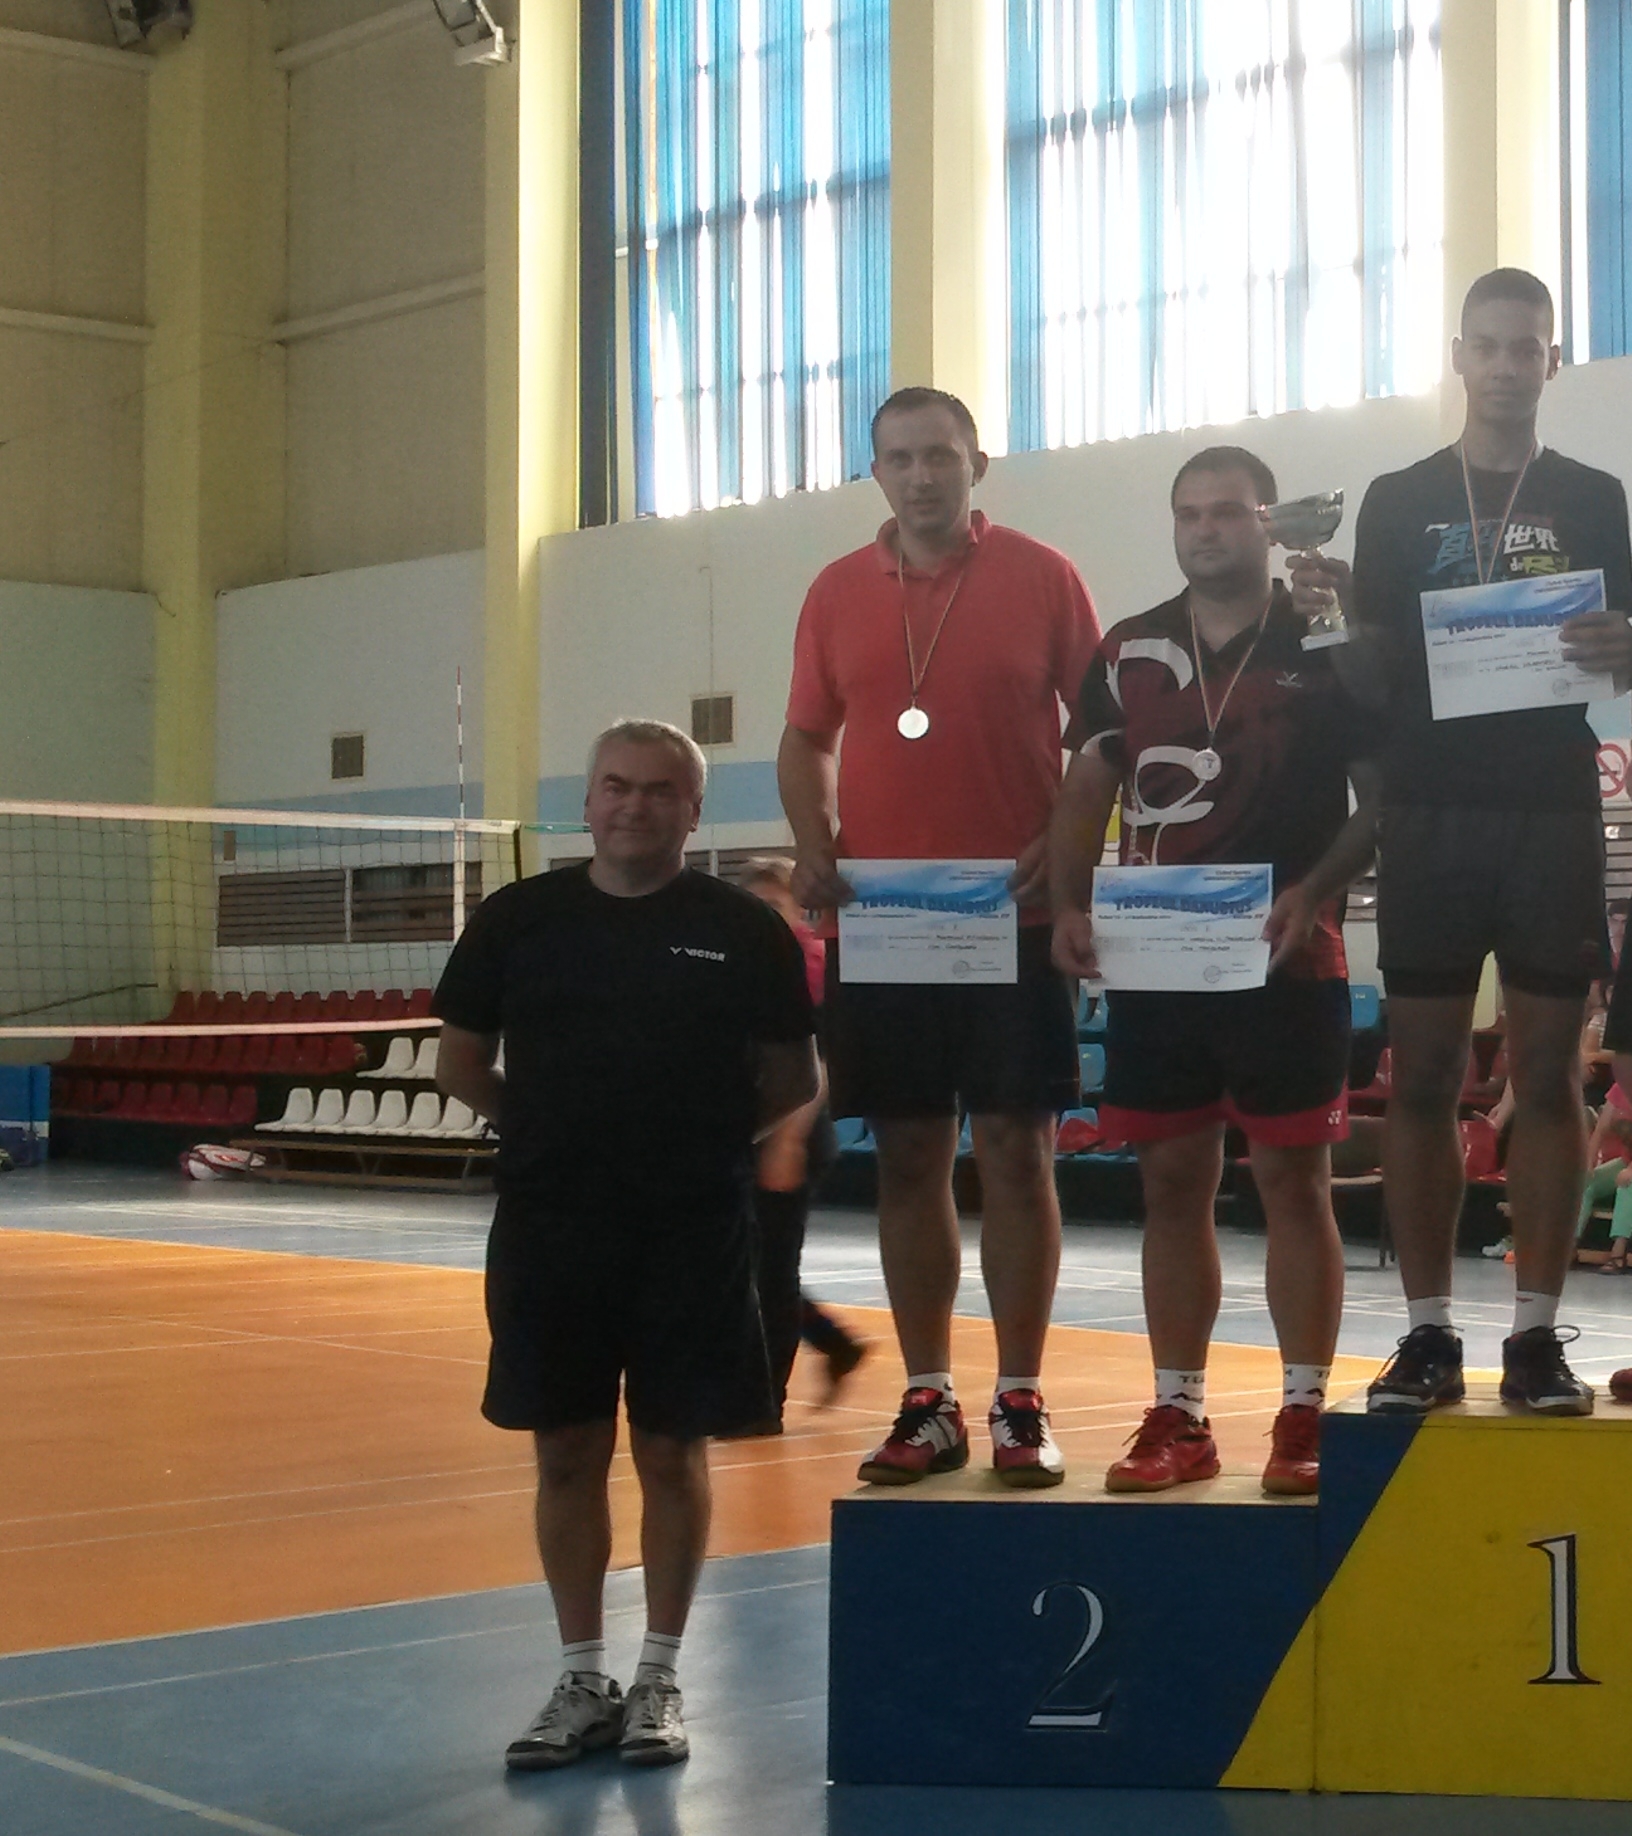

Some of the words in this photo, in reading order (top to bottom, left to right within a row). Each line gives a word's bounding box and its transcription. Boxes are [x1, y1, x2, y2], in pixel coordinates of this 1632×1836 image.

[684, 947, 726, 962] VICTOR
[1024, 1579, 1118, 1734] 2
[1527, 1533, 1602, 1685] 1
